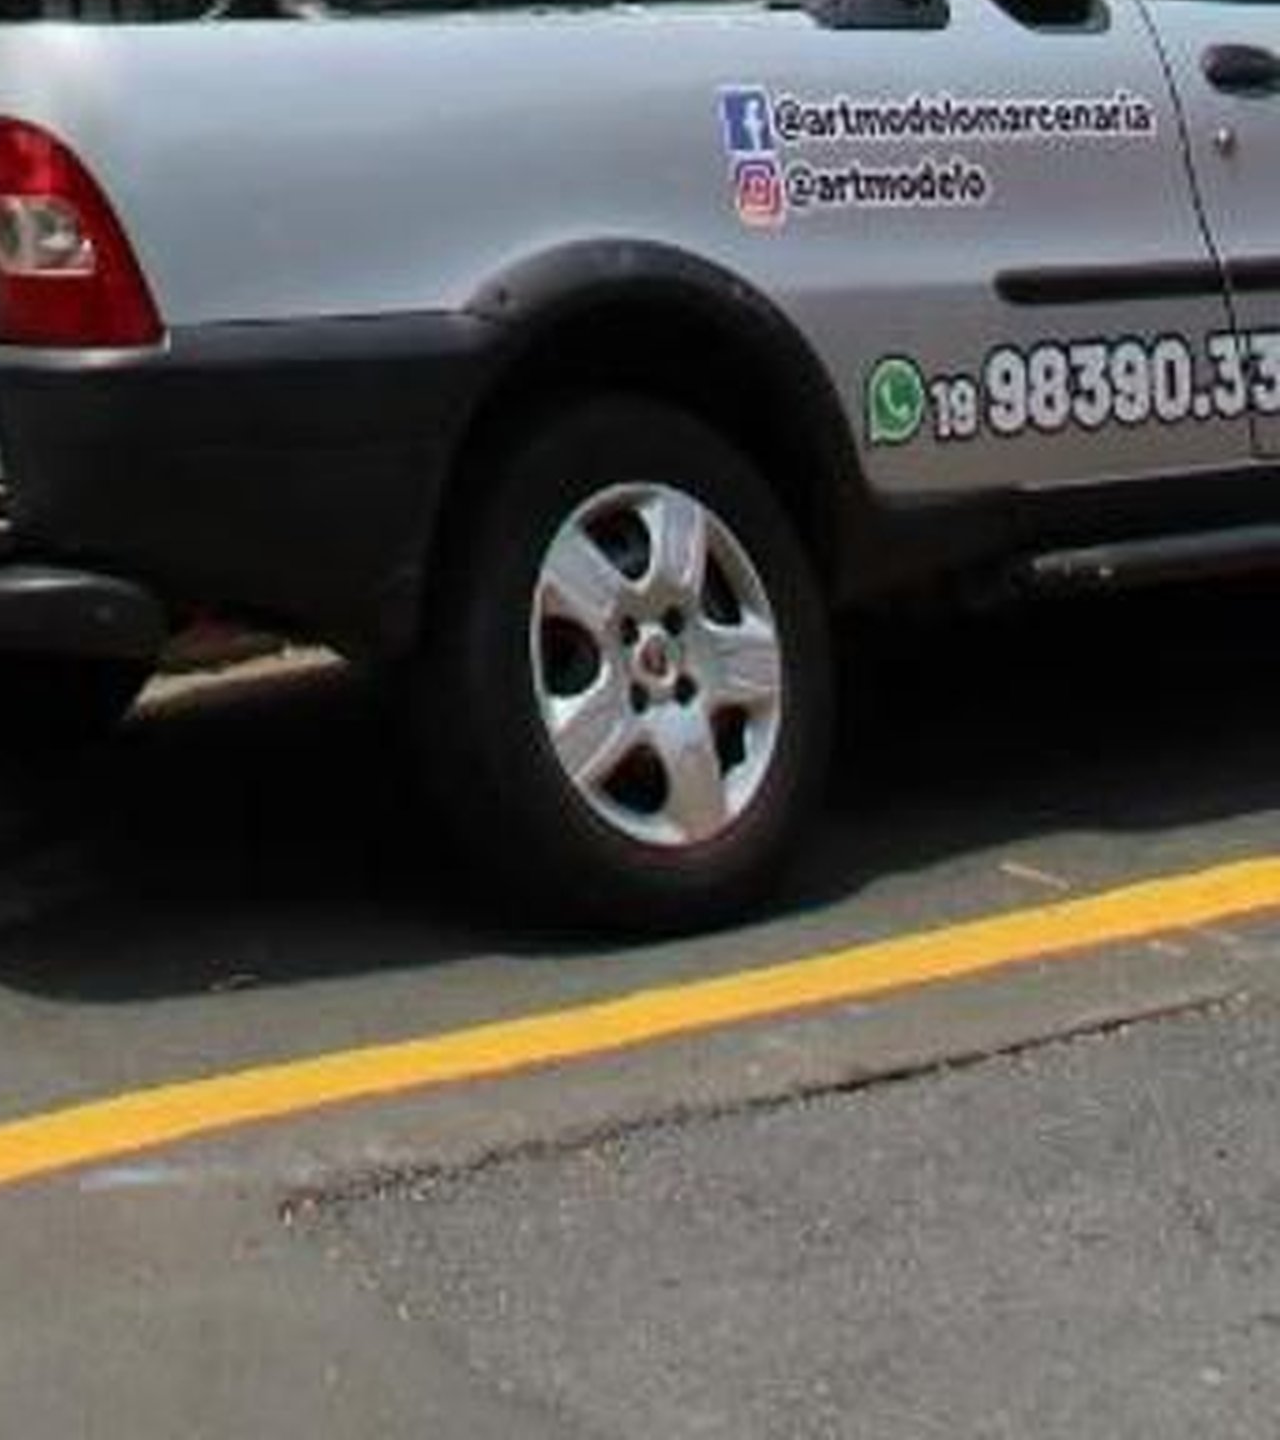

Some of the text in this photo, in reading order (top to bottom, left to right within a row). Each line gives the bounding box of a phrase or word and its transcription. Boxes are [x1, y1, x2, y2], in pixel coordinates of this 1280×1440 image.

[774, 93, 1153, 141] @artmodelomarcenaria
[786, 162, 987, 207] @artmodelo
[929, 376, 978, 440] 19
